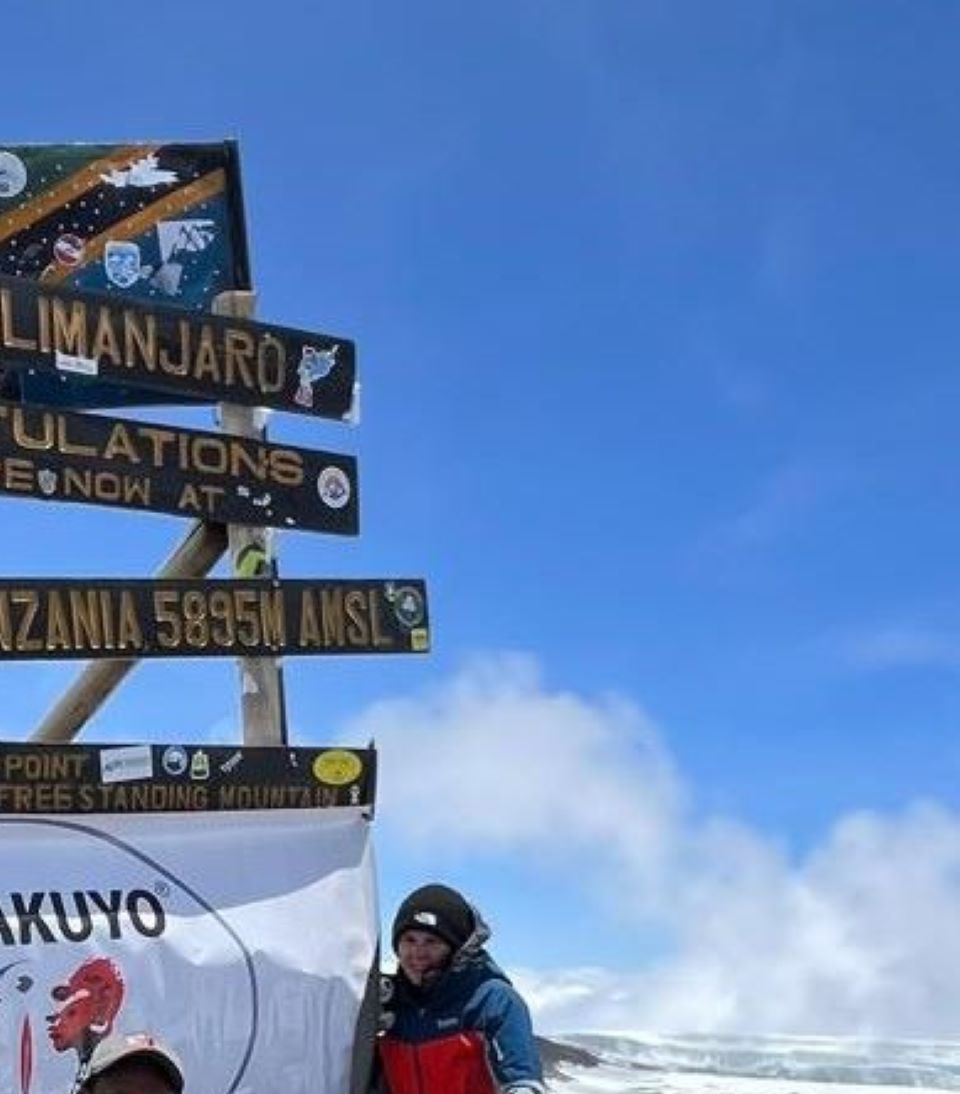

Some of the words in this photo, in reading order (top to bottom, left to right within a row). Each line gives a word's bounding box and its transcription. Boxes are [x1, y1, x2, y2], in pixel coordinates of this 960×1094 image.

[65, 463, 152, 506] NOW
[178, 482, 225, 514] AT
[298, 588, 394, 648] AMSL
[6, 753, 88, 780] POINT
